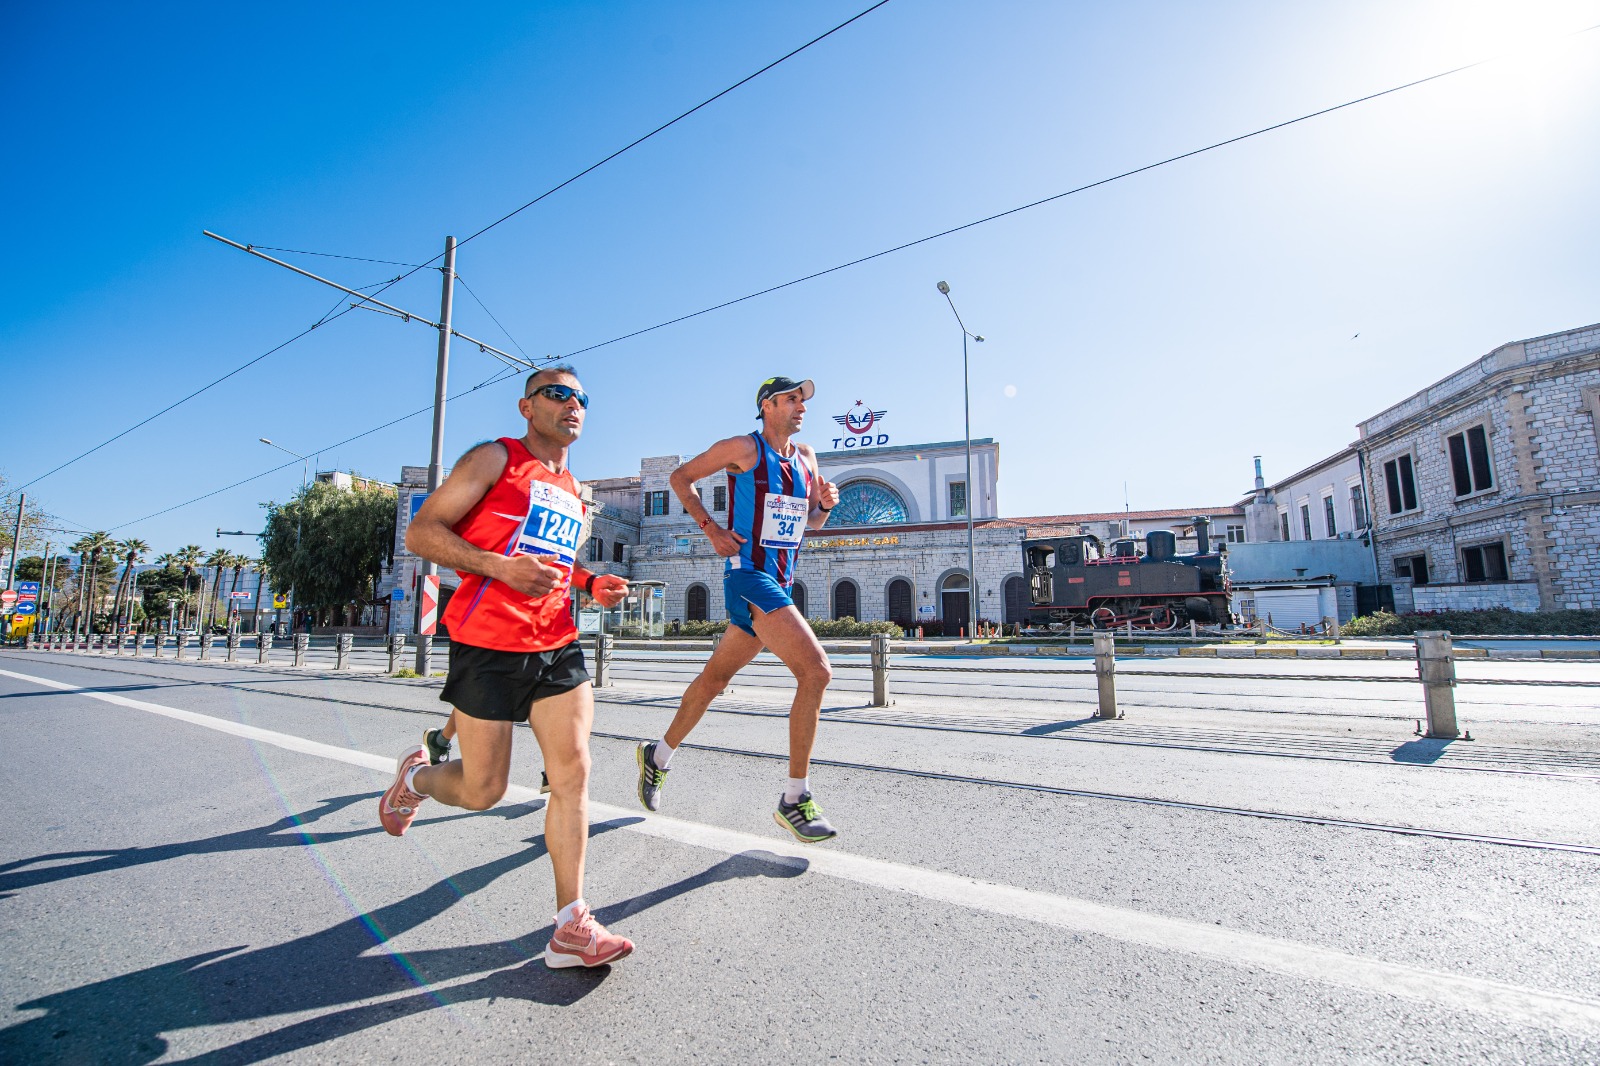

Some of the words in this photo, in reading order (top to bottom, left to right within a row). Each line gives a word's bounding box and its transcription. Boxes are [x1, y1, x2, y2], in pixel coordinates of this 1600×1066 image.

[832, 434, 889, 449] TCDD
[772, 513, 802, 522] MURAT
[537, 510, 579, 547] 1244
[777, 521, 795, 536] 34
[807, 537, 870, 548] ALSANCAK
[873, 536, 899, 545] GAR
